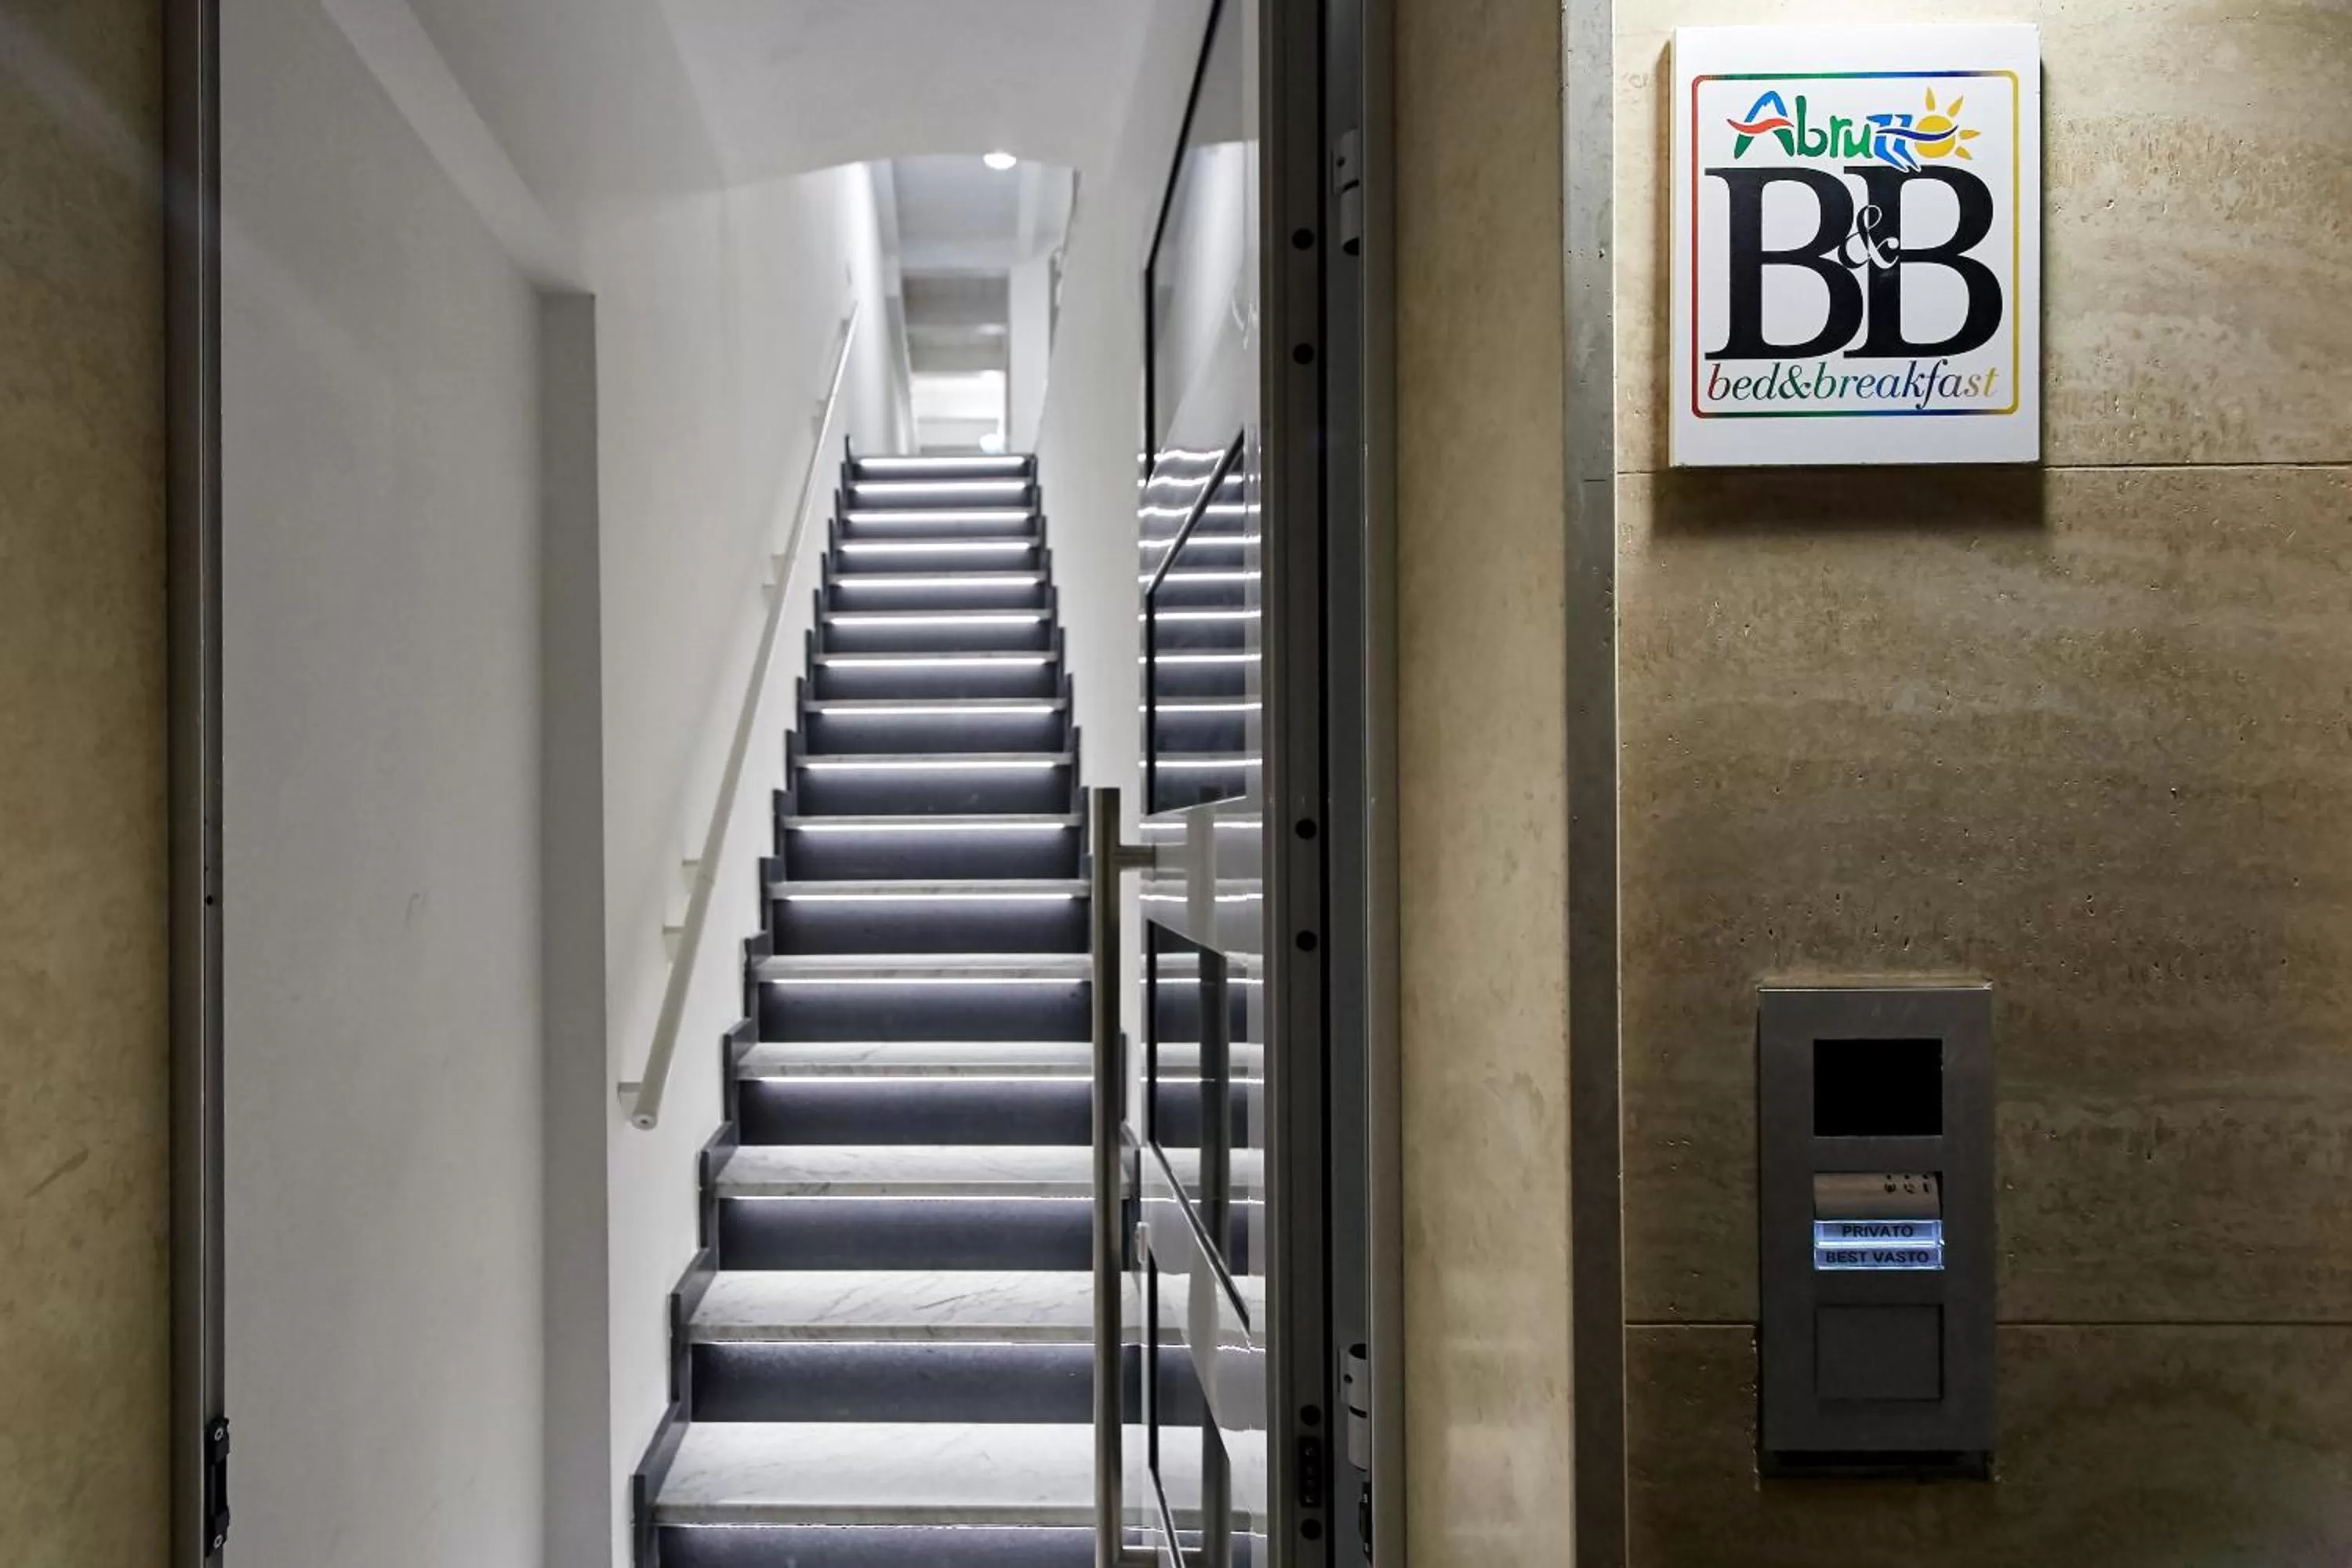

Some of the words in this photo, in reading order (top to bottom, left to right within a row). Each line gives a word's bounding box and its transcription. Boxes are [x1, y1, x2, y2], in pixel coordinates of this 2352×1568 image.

[1704, 165, 2002, 360] B&B
[1707, 360, 2000, 410] bed&breakfast
[1842, 1225, 1914, 1237] PRIVATO
[1825, 1251, 1866, 1263] BEST
[1873, 1250, 1929, 1263] VASTO
